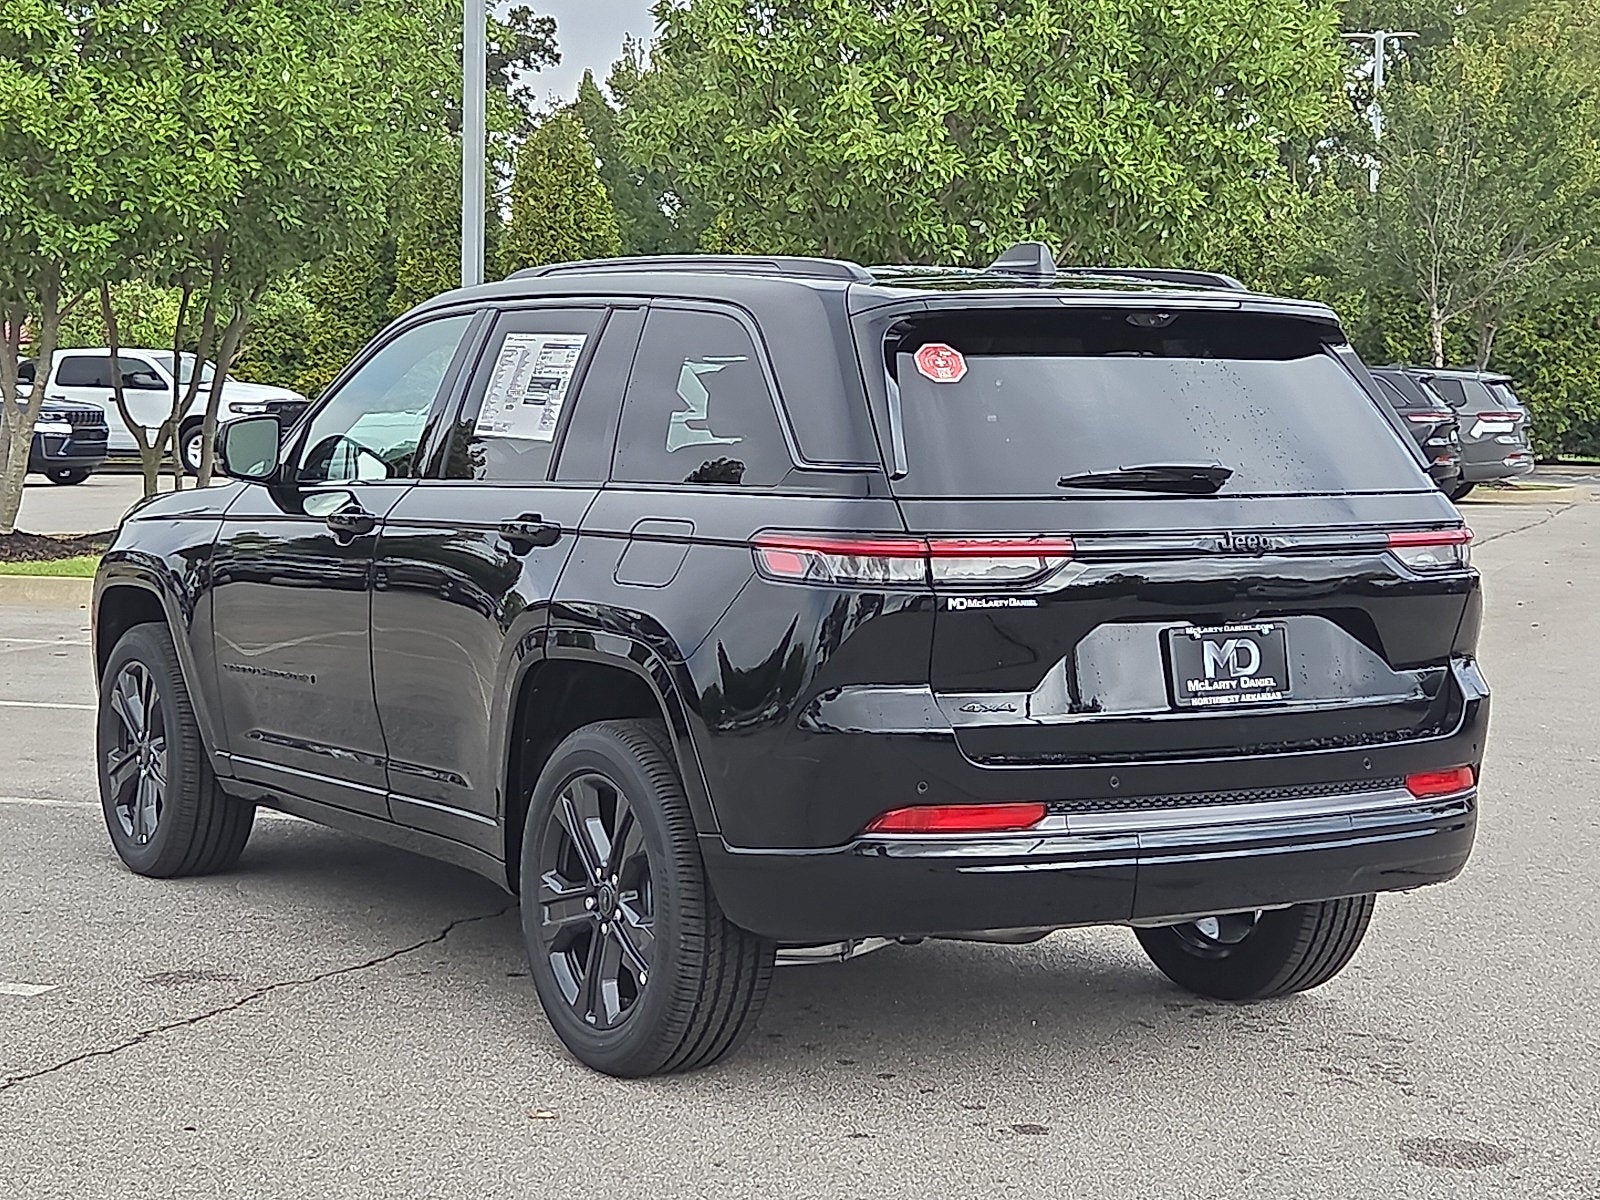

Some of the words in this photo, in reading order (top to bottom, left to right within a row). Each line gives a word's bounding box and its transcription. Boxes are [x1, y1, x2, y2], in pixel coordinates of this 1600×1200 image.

[1216, 530, 1273, 552] Jeep
[1203, 639, 1260, 678] MD
[1240, 692, 1282, 701] ARKANSAS
